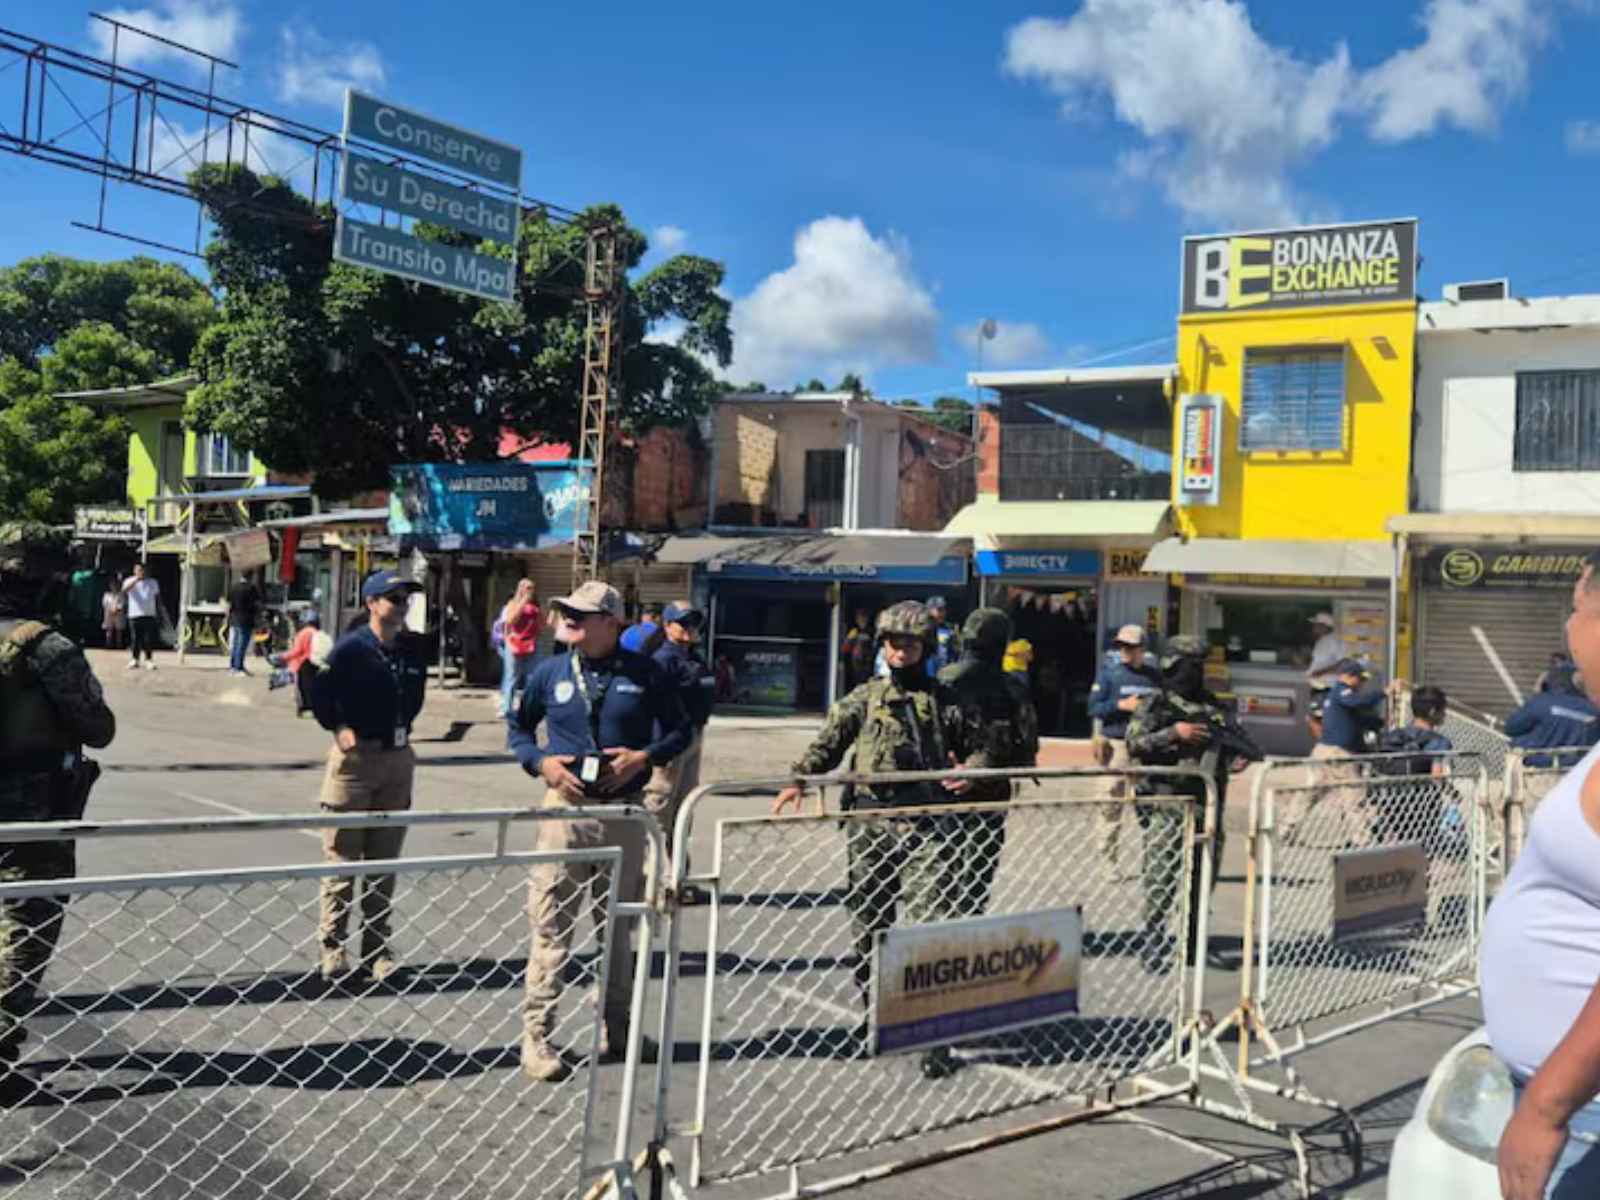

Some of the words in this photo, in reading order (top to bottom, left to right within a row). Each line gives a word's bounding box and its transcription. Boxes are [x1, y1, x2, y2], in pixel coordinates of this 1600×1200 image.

[374, 107, 501, 172] Conserve
[353, 163, 389, 197] Su
[400, 177, 510, 233] Derecha
[350, 226, 446, 276] Transito
[1195, 237, 1271, 308] BE
[1273, 229, 1400, 266] BONANZA
[1272, 257, 1400, 293] EXCHANGE
[1005, 554, 1070, 570] DIRECTV
[904, 939, 1046, 992] MIGRACIÓN
